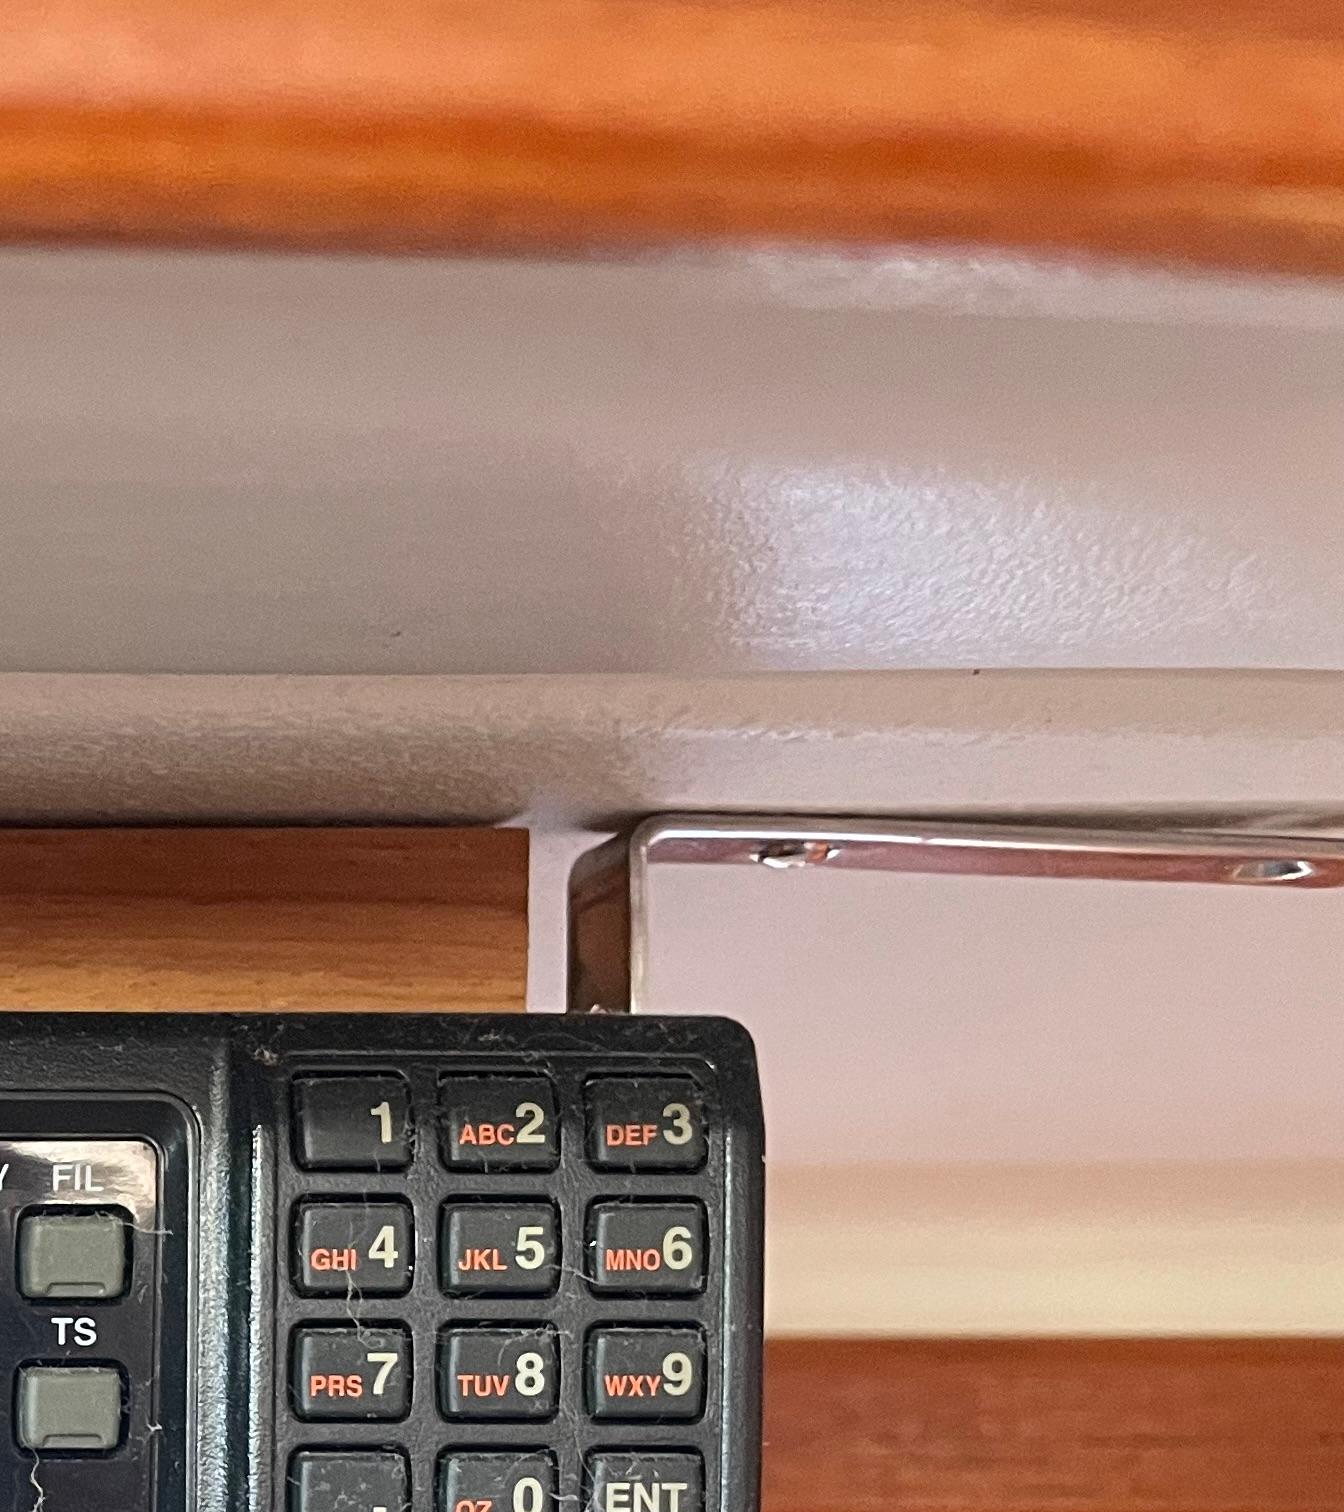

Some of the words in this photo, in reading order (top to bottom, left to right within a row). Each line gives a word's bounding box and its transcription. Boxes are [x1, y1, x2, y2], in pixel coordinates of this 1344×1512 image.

[370, 1101, 392, 1144] 1
[458, 1124, 514, 1147] ABC
[515, 1102, 546, 1144] 2
[606, 1124, 658, 1147] DEF
[662, 1103, 694, 1146] 3
[52, 1165, 105, 1192] FIL
[311, 1248, 357, 1271] GHI
[368, 1225, 399, 1269] 4
[458, 1248, 508, 1271] JKL
[514, 1226, 545, 1270] 5
[605, 1249, 661, 1272] MNO
[662, 1226, 694, 1270] 6
[50, 1317, 98, 1347] TS
[310, 1374, 363, 1398] PRS
[366, 1352, 399, 1396] 7
[457, 1374, 510, 1397] TUV
[514, 1352, 545, 1396] 8
[604, 1374, 661, 1397] WXY
[662, 1352, 694, 1396] 9
